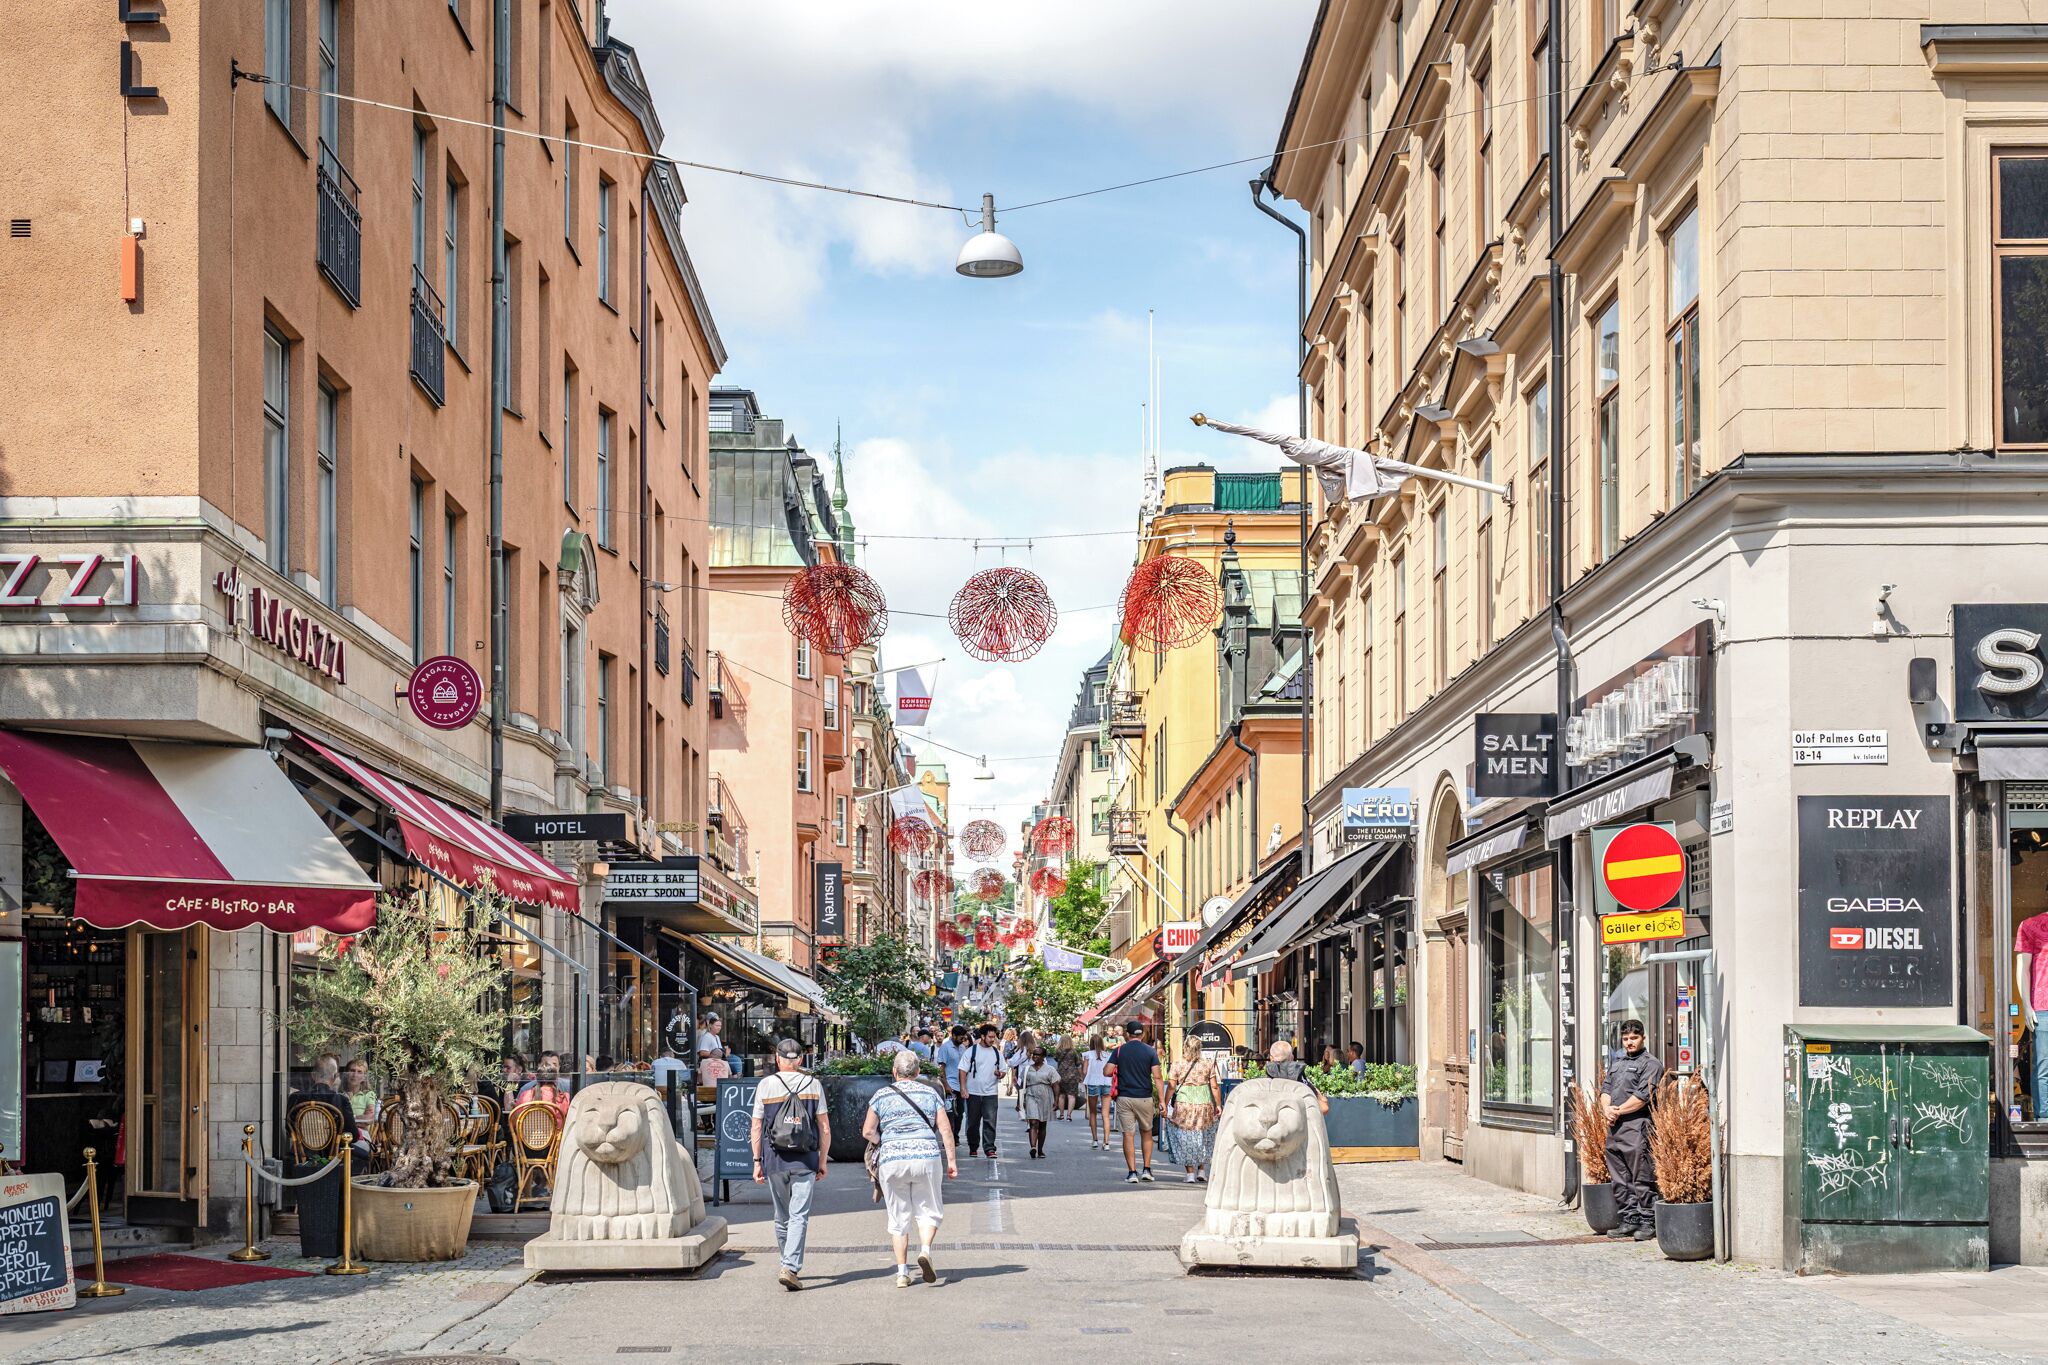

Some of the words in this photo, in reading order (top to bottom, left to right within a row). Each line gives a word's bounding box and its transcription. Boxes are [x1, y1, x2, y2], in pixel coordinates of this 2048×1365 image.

[0, 554, 138, 606] ZZI
[250, 587, 347, 685] RAGAZZI
[1977, 628, 2044, 695] S
[421, 665, 457, 683] RAGAZZI
[433, 702, 469, 720] RAGAZZI
[1482, 734, 1553, 752] SALT
[1795, 733, 1815, 744] Olof
[1819, 733, 1854, 744] Palmes
[1858, 733, 1882, 743] Gata
[1795, 750, 1821, 761] 18-14
[1487, 757, 1549, 775] MEN
[1347, 803, 1408, 820] NERO
[1580, 797, 1604, 827] SALT
[1604, 786, 1628, 817] MEN
[1827, 808, 1922, 829] REPLAY
[535, 821, 587, 835] HOTEL
[611, 874, 648, 884] TEATER
[652, 874, 660, 884] &
[665, 874, 686, 884] BAR
[611, 888, 648, 898] GREASY
[654, 888, 686, 898] SPOON
[822, 873, 838, 926] Insurely
[165, 896, 203, 912] CAFE
[211, 897, 260, 915] BISTRO
[267, 899, 296, 914] BAR
[1827, 897, 1924, 913] GABBA
[1606, 922, 1641, 935] Gäller
[1645, 920, 1656, 933] ej
[1865, 927, 1924, 950] DIESEL
[0, 1220, 47, 1241] PRITZ
[23, 1286, 69, 1304] APERITIVO
